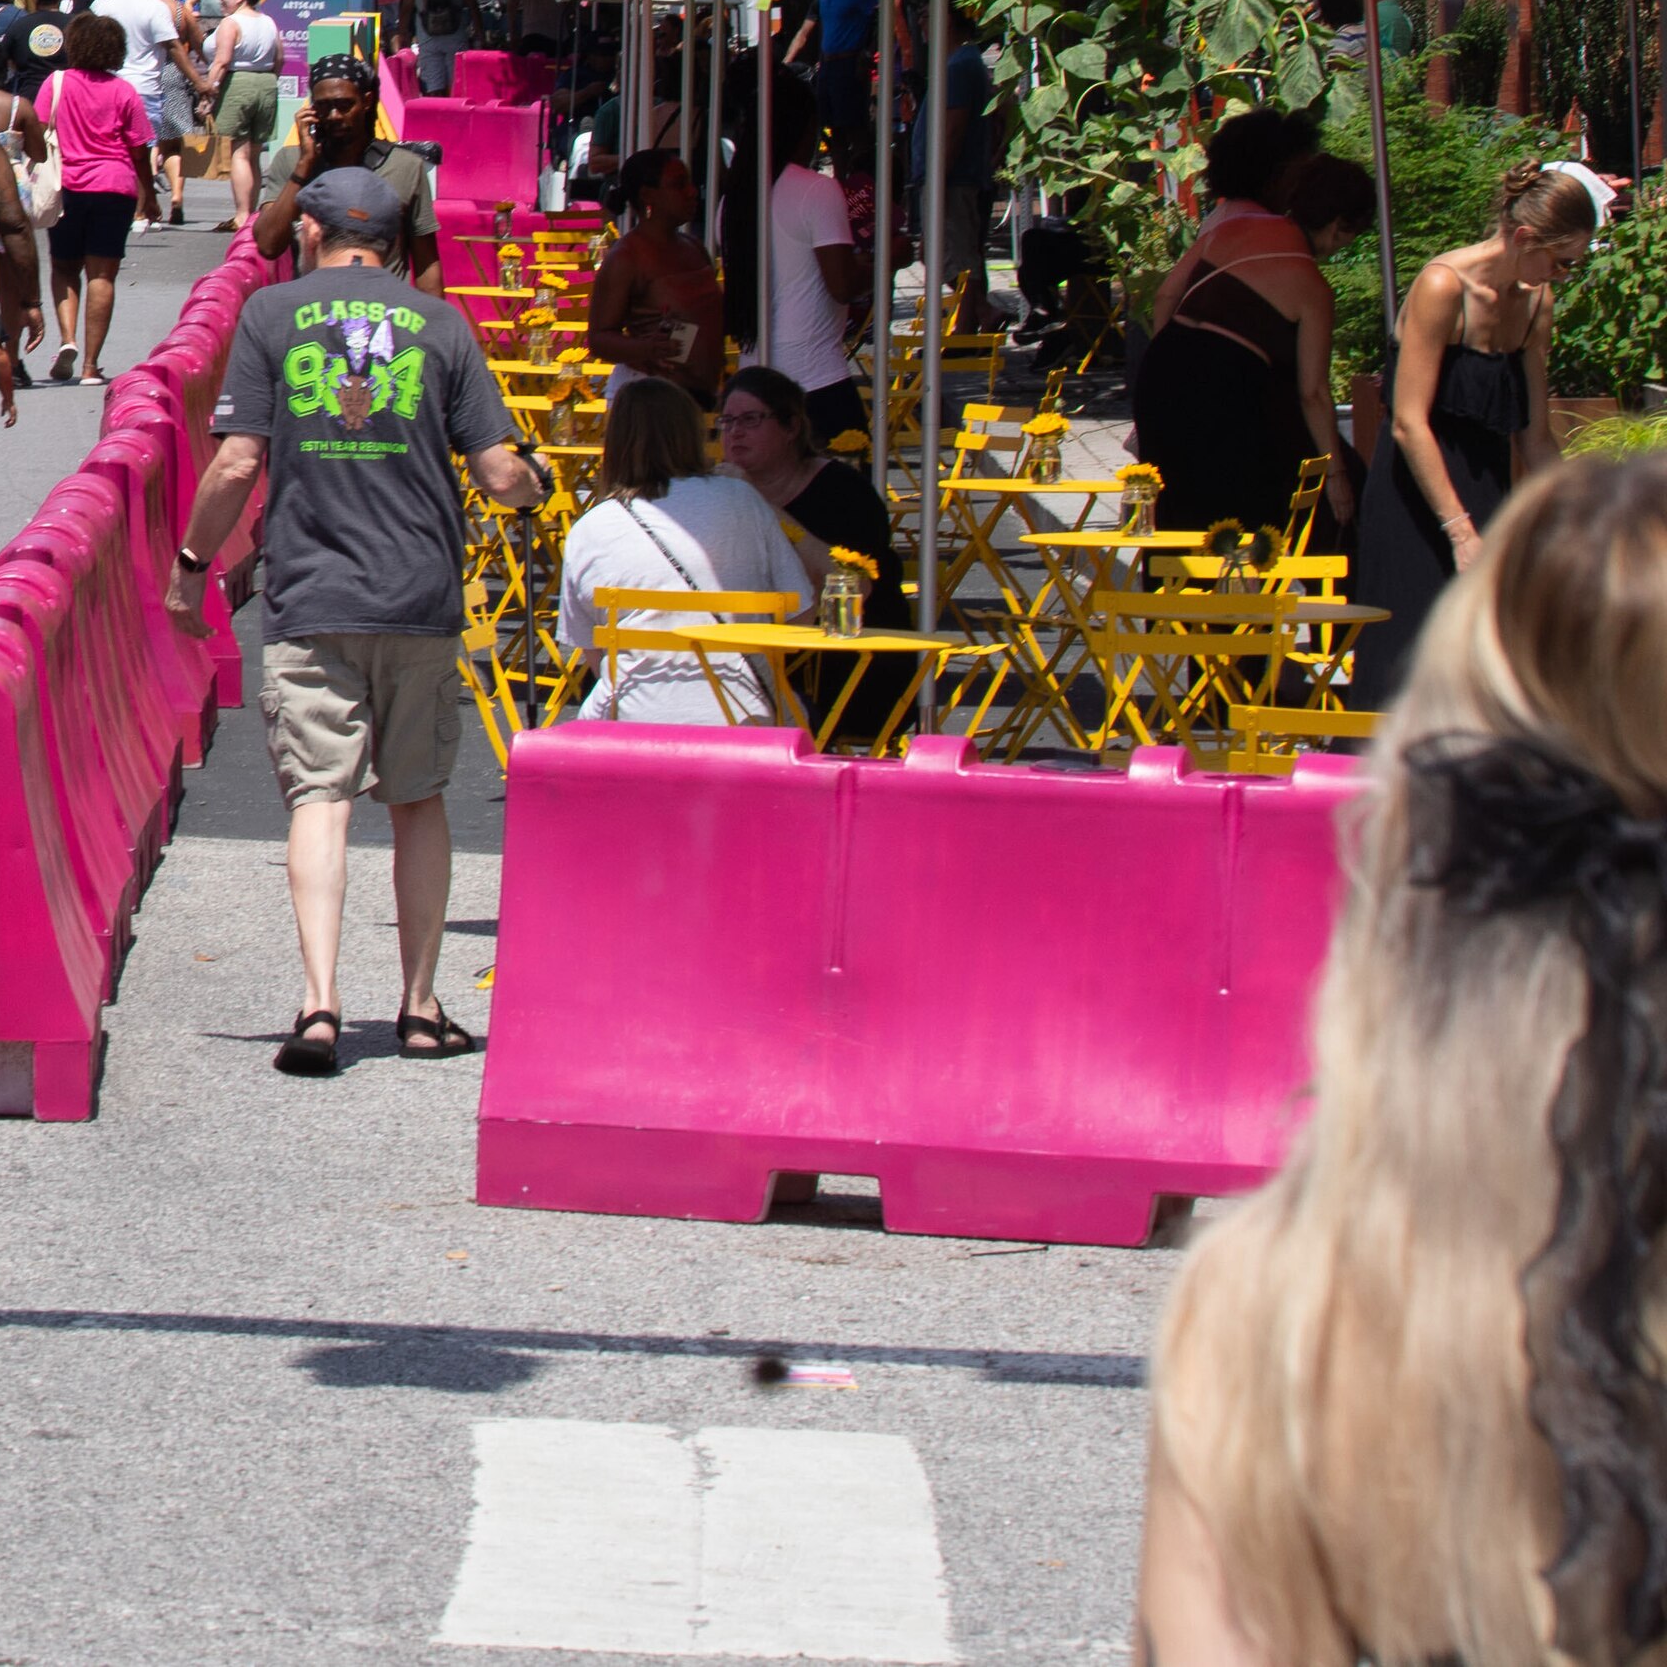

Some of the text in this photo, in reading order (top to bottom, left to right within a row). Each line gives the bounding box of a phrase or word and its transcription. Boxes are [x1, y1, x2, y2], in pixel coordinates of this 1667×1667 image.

[283, 1, 325, 10] ARTSCAPE
[294, 299, 427, 335] CLASS OF
[331, 440, 358, 452] YEAR
